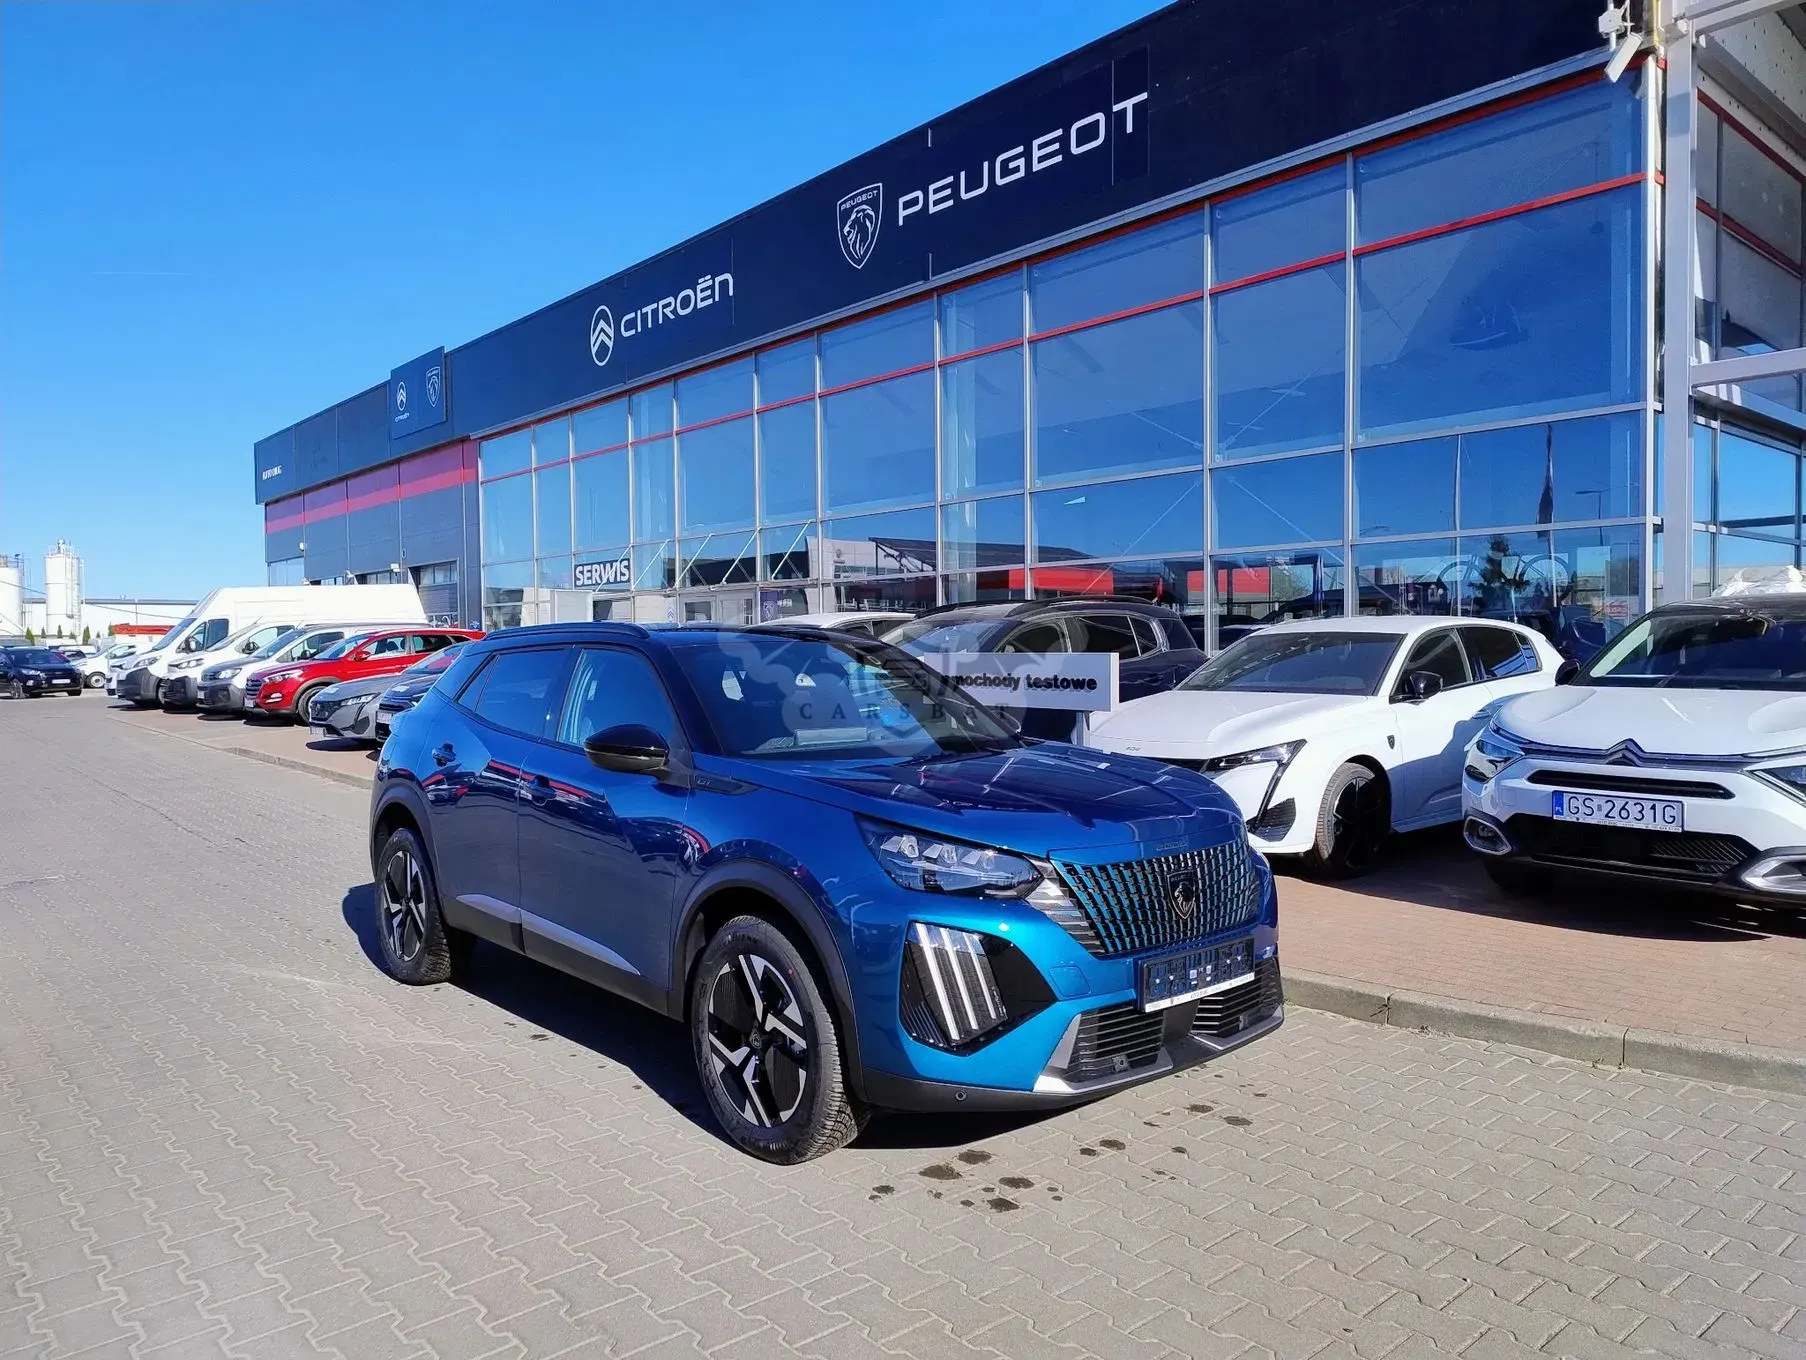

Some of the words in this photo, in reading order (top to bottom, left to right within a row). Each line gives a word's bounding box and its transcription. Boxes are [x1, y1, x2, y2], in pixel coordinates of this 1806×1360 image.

[898, 91, 1148, 227] PEUGEOT
[840, 190, 878, 212] PEUGEOT
[575, 560, 630, 586] SERWIS
[1025, 674, 1098, 692] testowe
[1568, 796, 1595, 817] GS
[1604, 800, 1677, 825] 2631G
